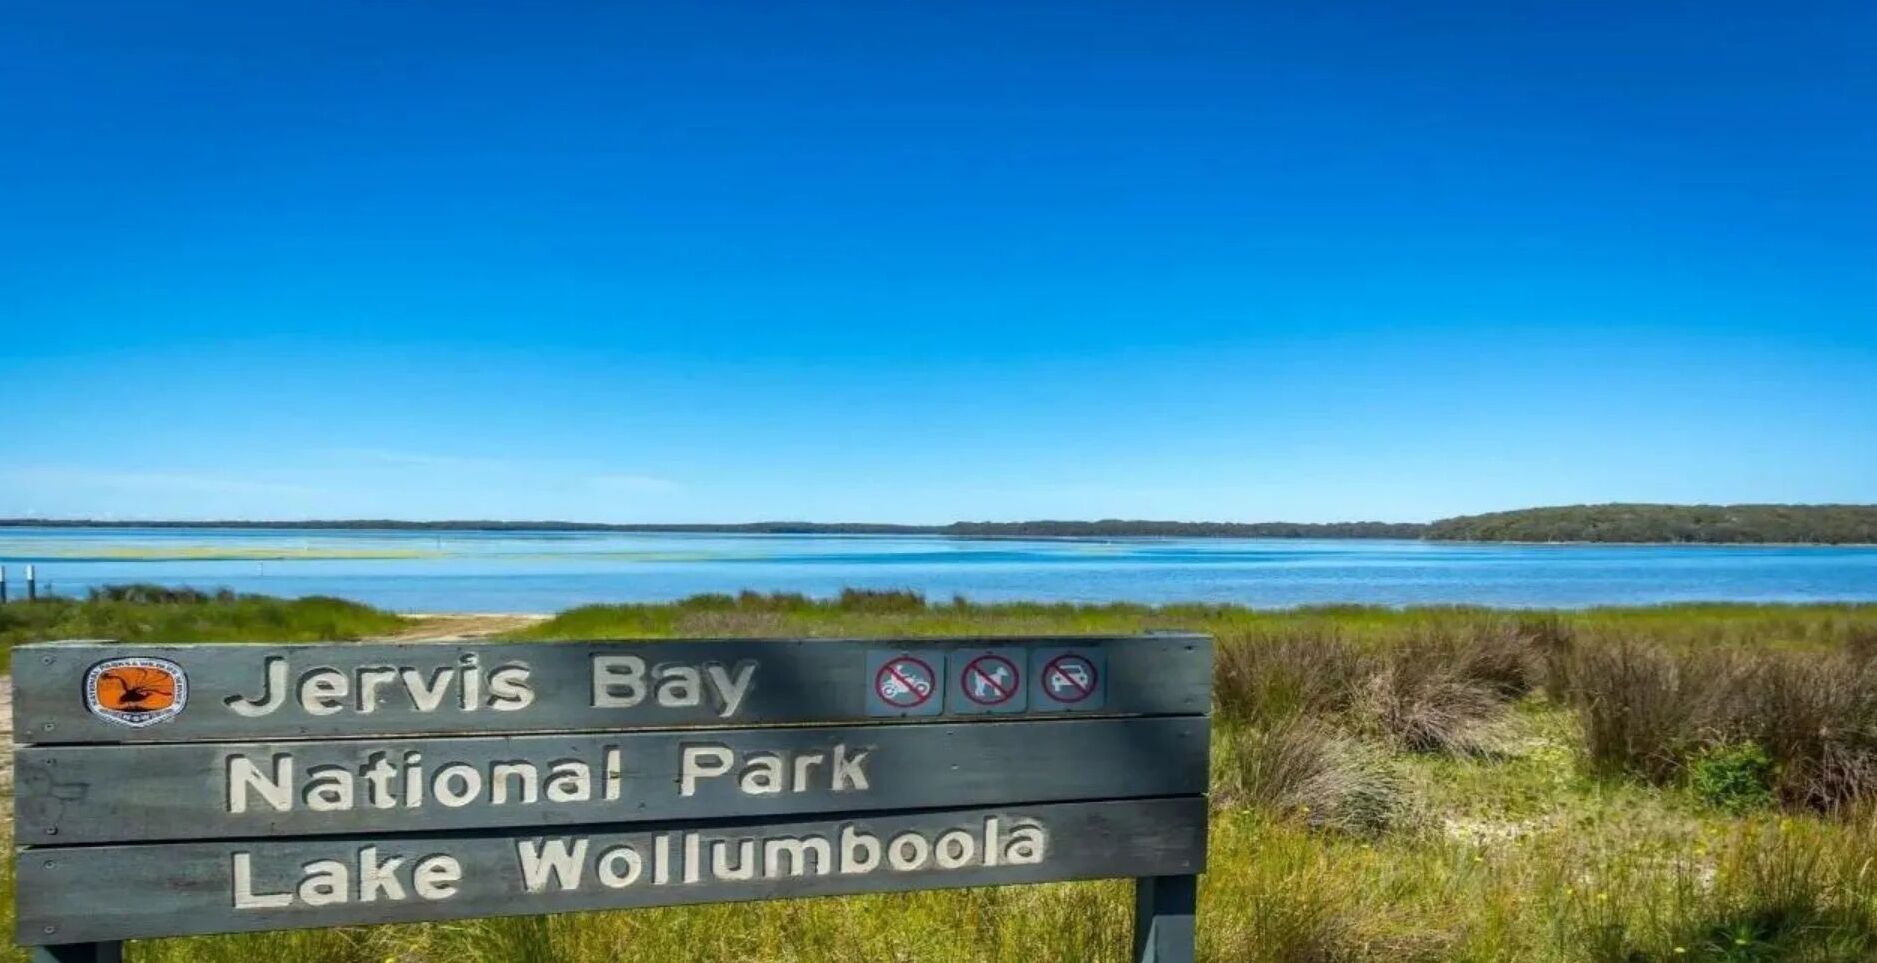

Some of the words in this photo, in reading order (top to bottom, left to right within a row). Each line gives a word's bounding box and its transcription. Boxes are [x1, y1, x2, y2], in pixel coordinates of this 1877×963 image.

[224, 652, 535, 717] Jervis
[591, 654, 758, 718] Bay
[226, 744, 621, 813] National
[680, 741, 872, 797] Park
[231, 845, 462, 909] Lake
[516, 815, 1047, 892] Wollumboola
